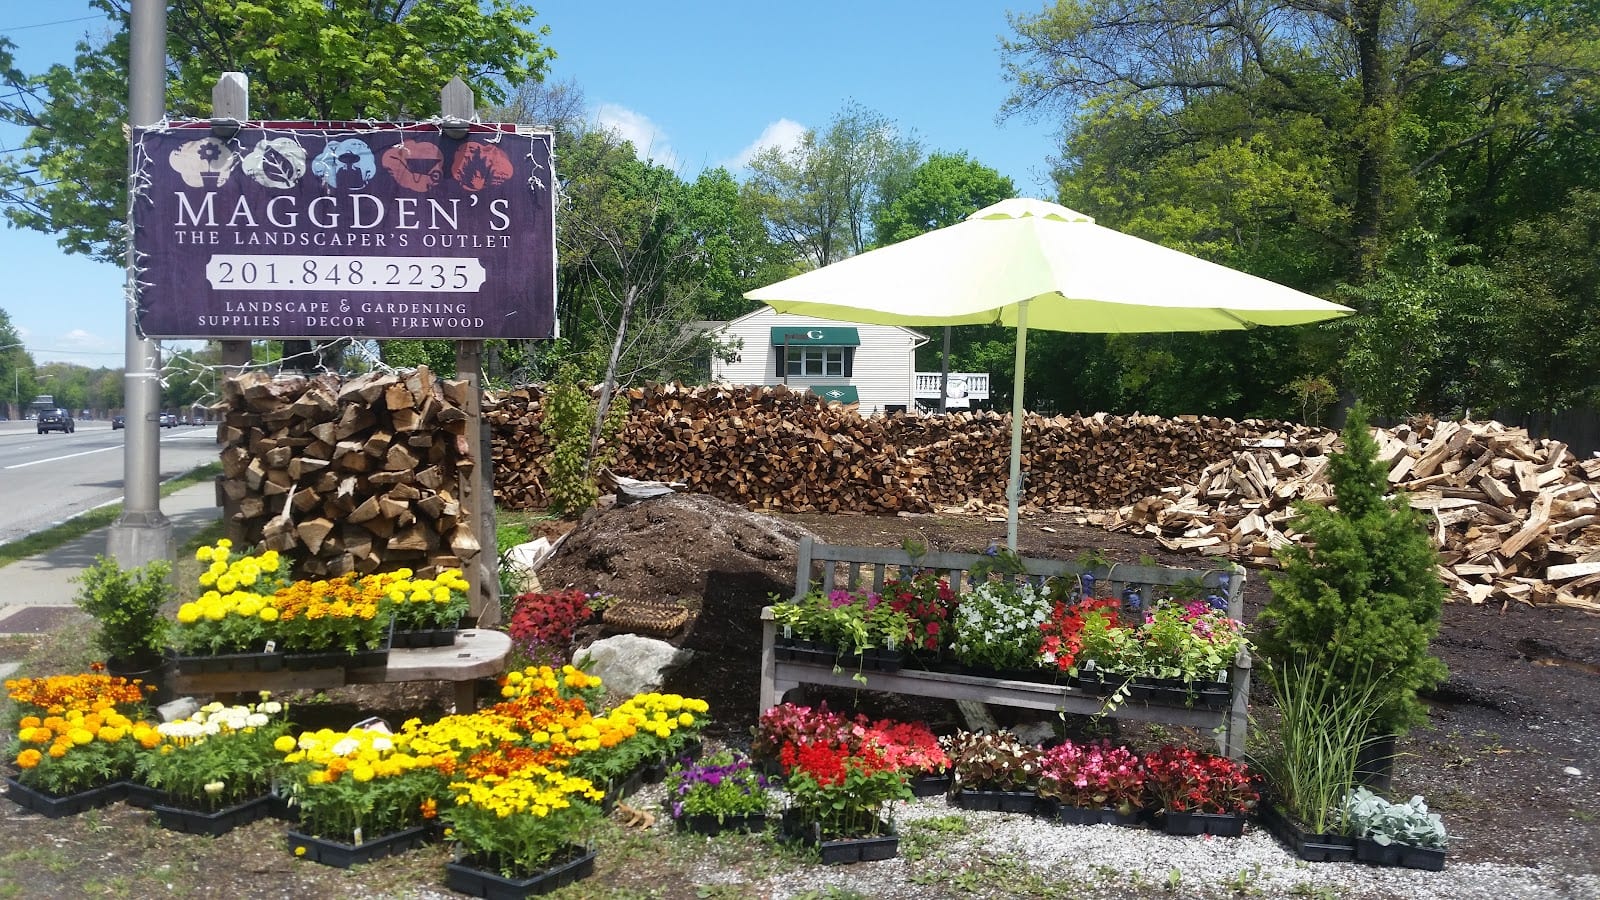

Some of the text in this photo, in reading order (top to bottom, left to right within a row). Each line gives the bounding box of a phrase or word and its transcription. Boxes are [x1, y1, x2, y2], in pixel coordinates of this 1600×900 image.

[174, 191, 510, 231] MAGGDEN'S
[175, 231, 511, 248] THE LANDSCAPER'S OUTLET
[219, 260, 468, 289] 201.848.2235
[226, 299, 467, 314] LANDSCAPE & GARDENING
[198, 315, 281, 326] SUPPLIES
[307, 316, 366, 327] DECOR
[392, 317, 485, 328] FIREWOOD
